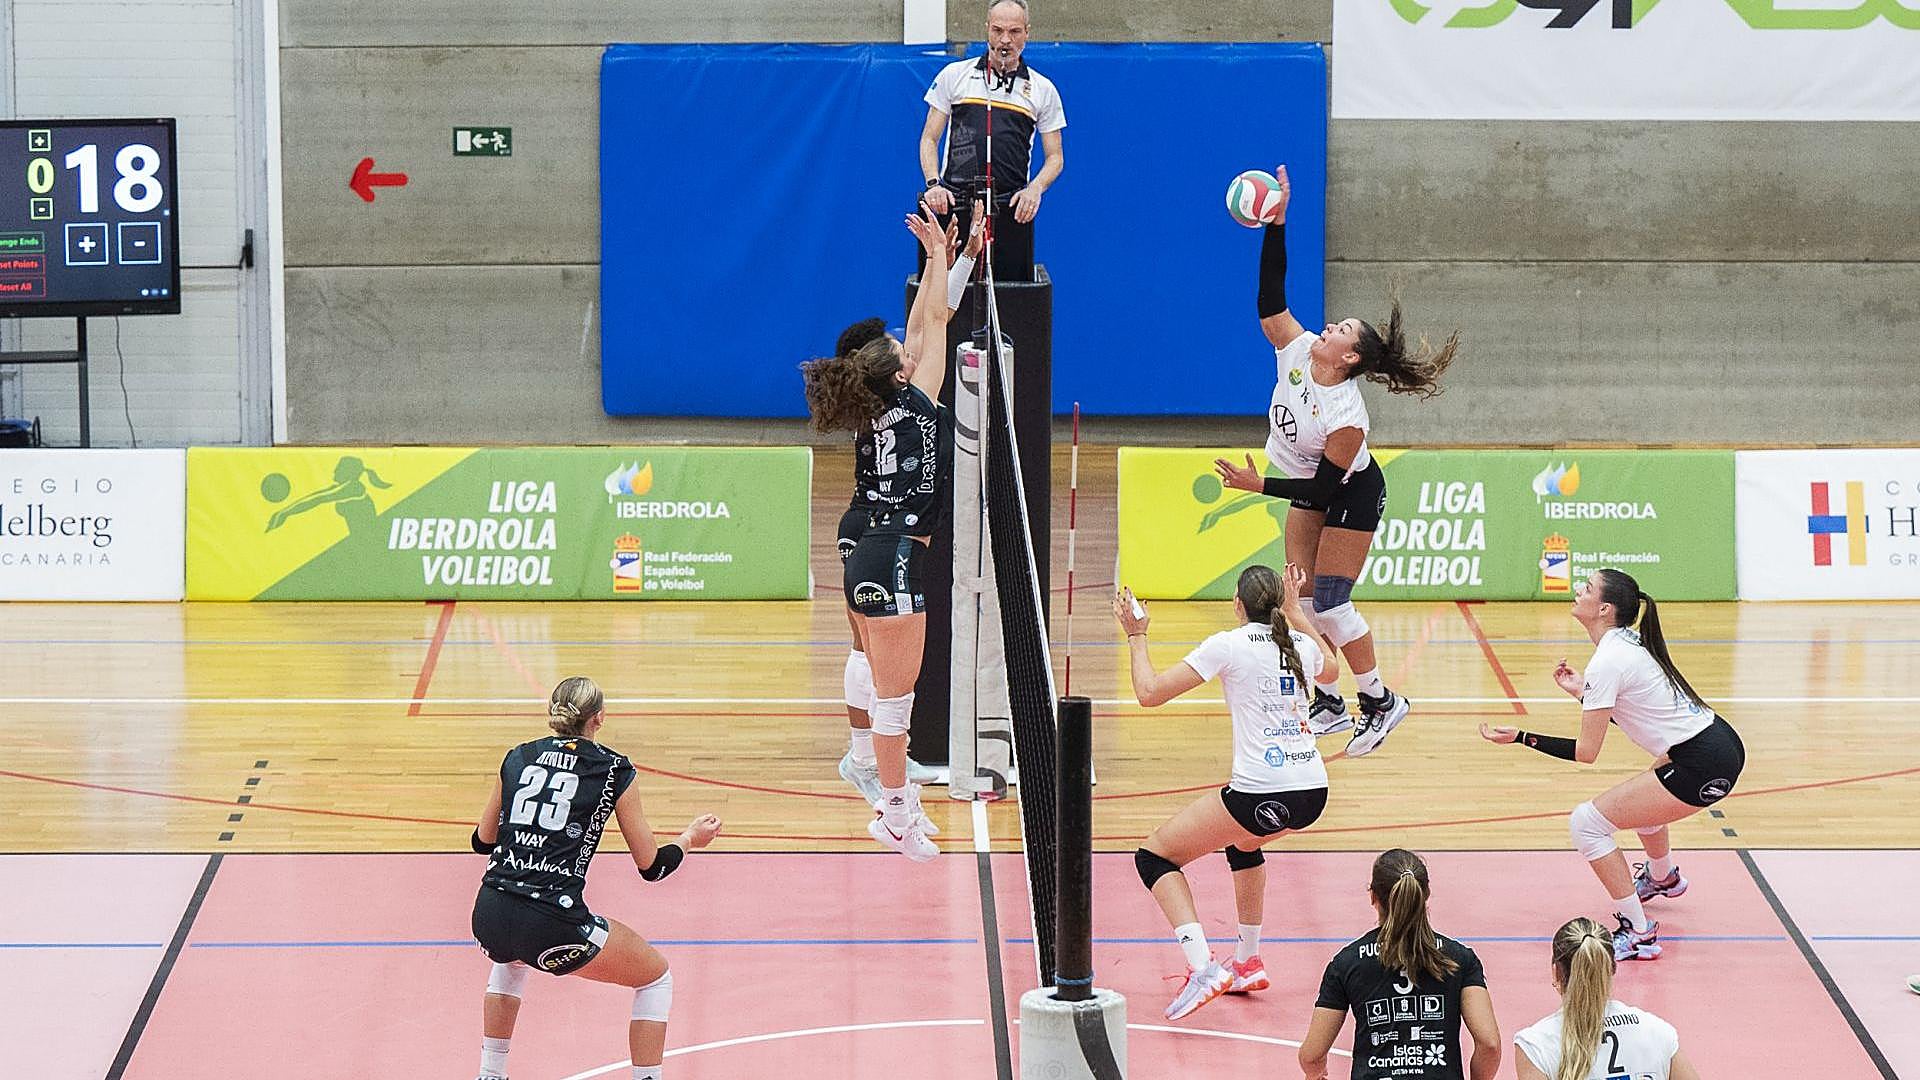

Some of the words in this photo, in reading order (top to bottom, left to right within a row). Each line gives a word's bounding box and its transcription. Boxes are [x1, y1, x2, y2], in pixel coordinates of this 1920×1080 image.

[27, 158, 54, 193] 0
[65, 144, 163, 213] 18
[488, 481, 557, 513] LIGA
[1418, 482, 1486, 514] LIGA
[616, 502, 730, 518] IBERDROLA
[1544, 502, 1657, 519] IBERDROLA
[388, 518, 557, 550] IBERDROLA
[2, 553, 111, 566] CANARIA
[644, 552, 669, 562] Real
[672, 552, 732, 562] Federación
[1573, 552, 1596, 563] Real
[1599, 552, 1660, 563] Federación
[422, 555, 553, 586] VOLEIBOL
[644, 566, 695, 577] Española
[644, 580, 658, 590] de
[661, 580, 704, 590] Voleibol
[509, 765, 579, 830] 23
[514, 831, 548, 848] WAY
[503, 849, 572, 877] Andalucía
[1394, 1044, 1423, 1056] Islas
[1601, 1030, 1625, 1074] 2
[1368, 1055, 1424, 1068] Canarias
